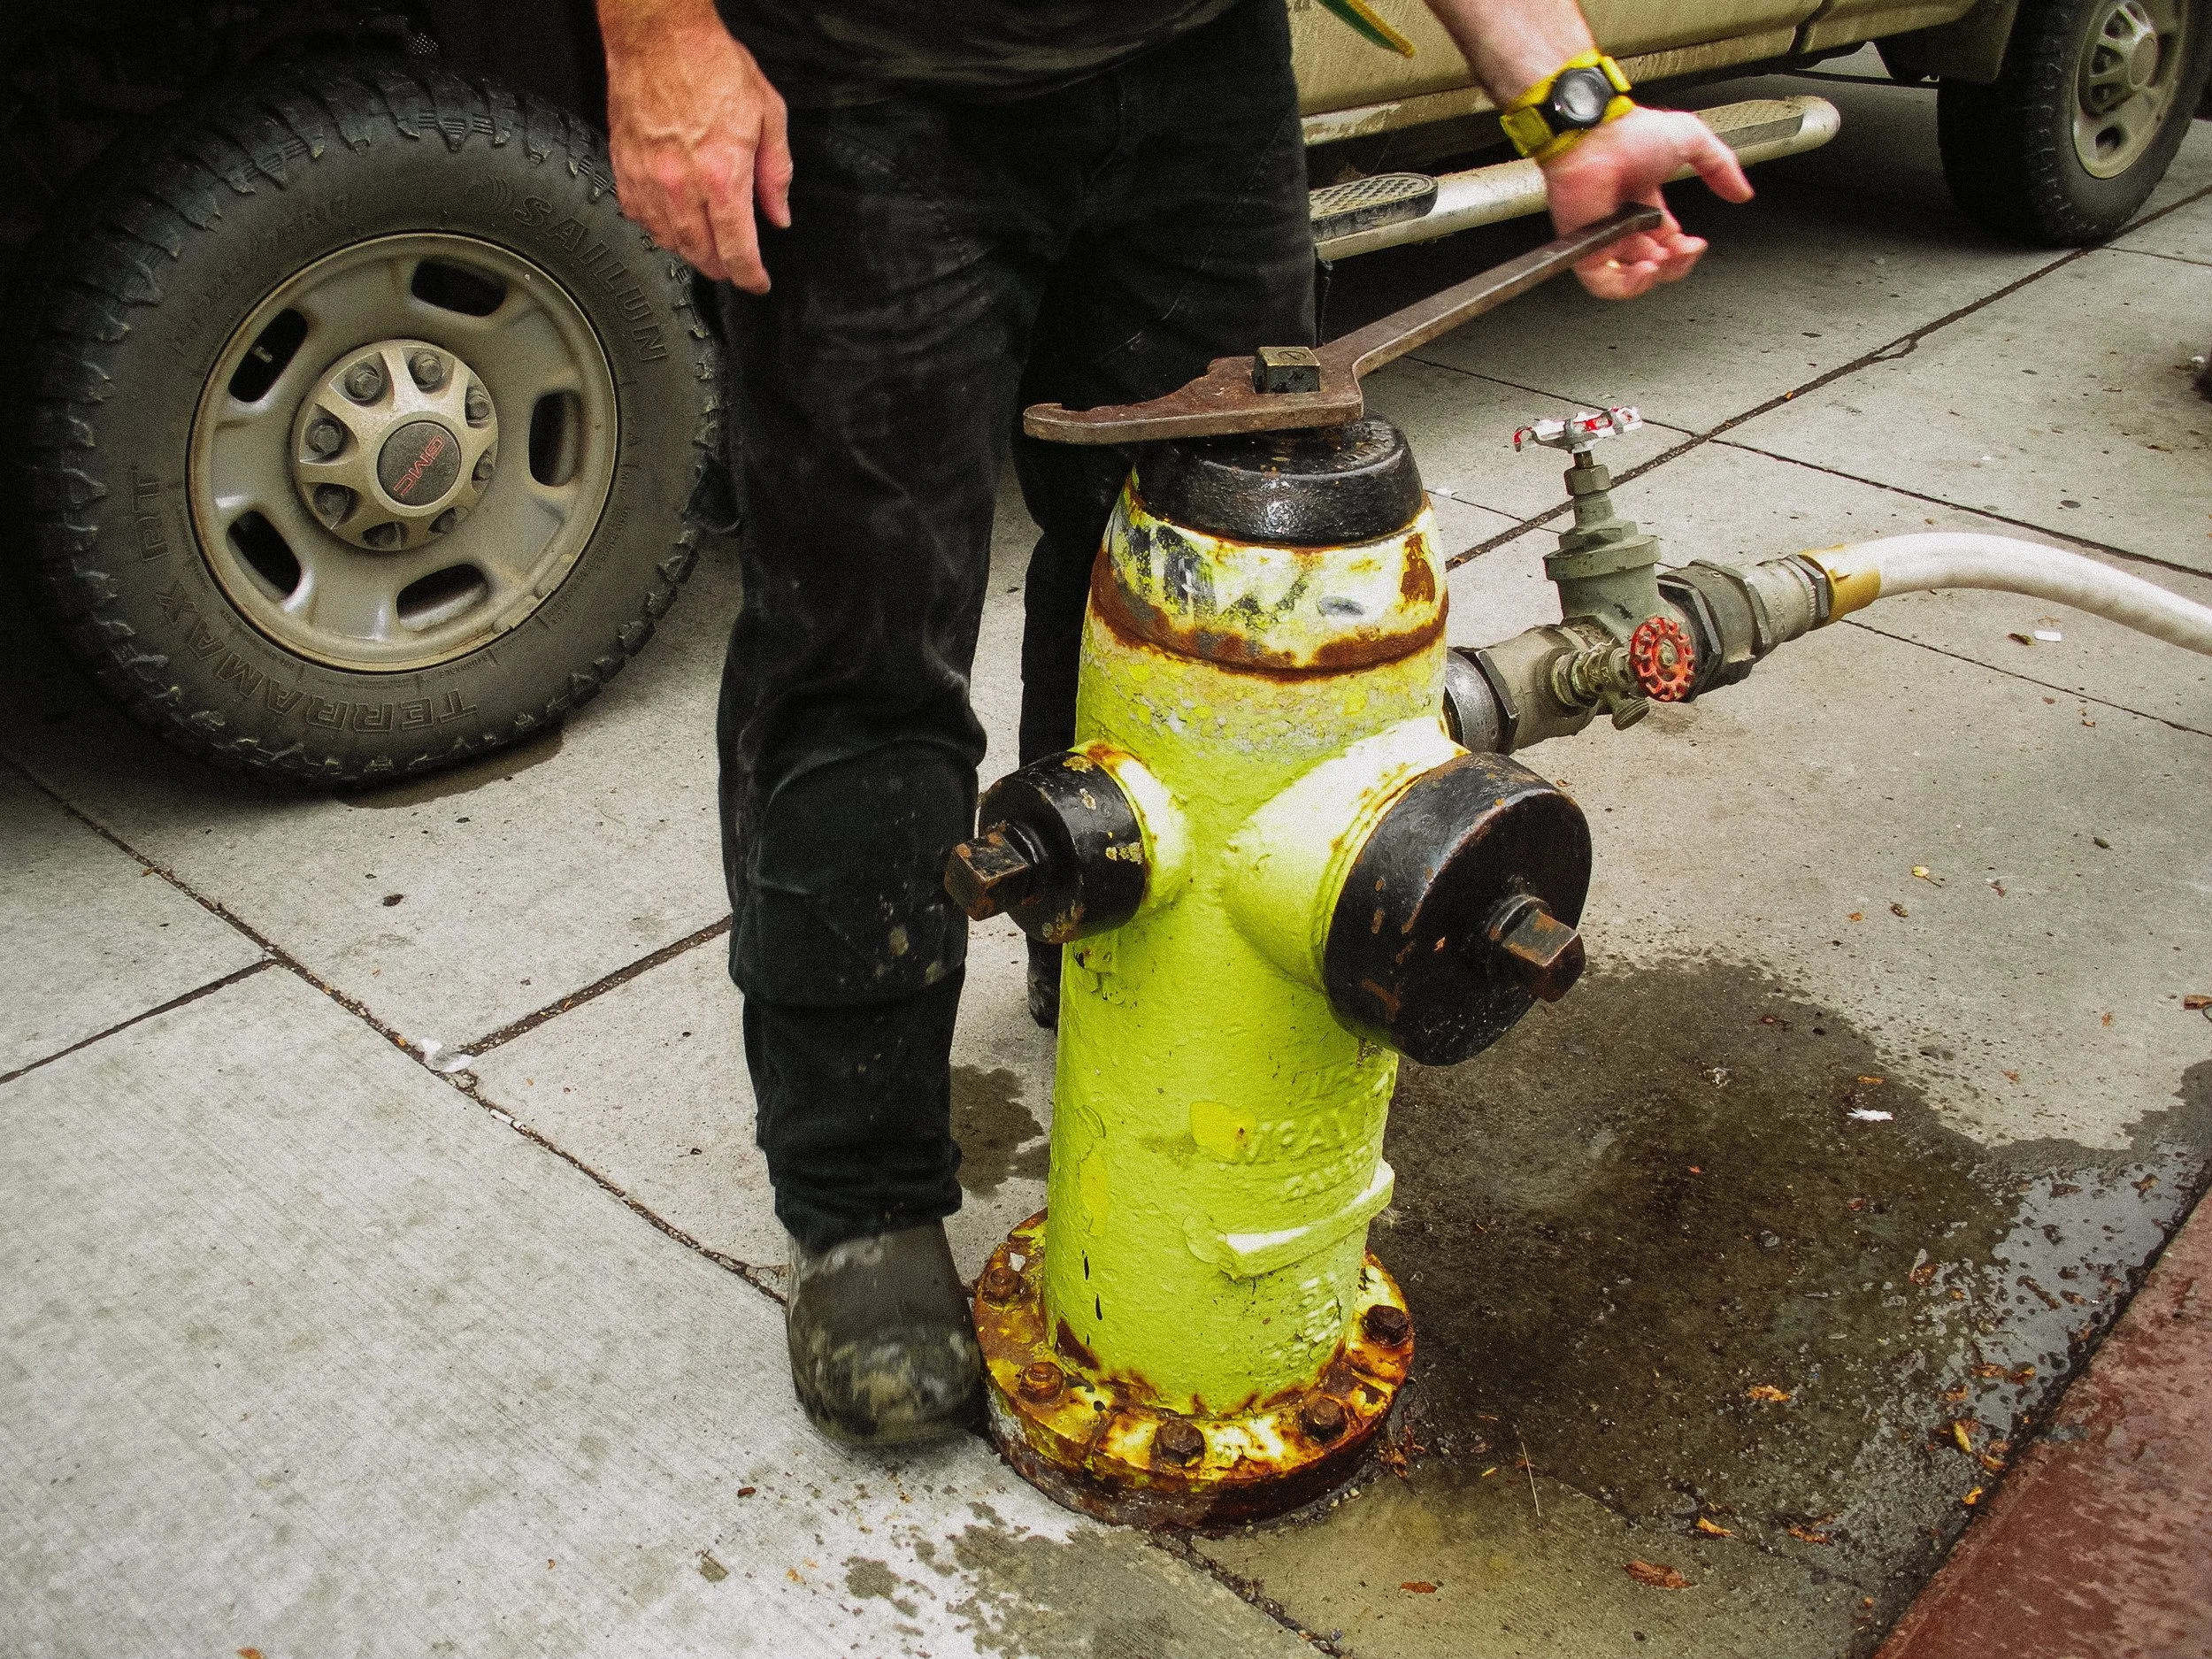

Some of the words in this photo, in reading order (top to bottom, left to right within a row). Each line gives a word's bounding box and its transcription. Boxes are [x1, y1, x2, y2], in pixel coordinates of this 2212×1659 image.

[513, 196, 668, 361] SAILUN
[393, 434, 445, 495] GMC
[156, 584, 478, 732] TERRAMAX
